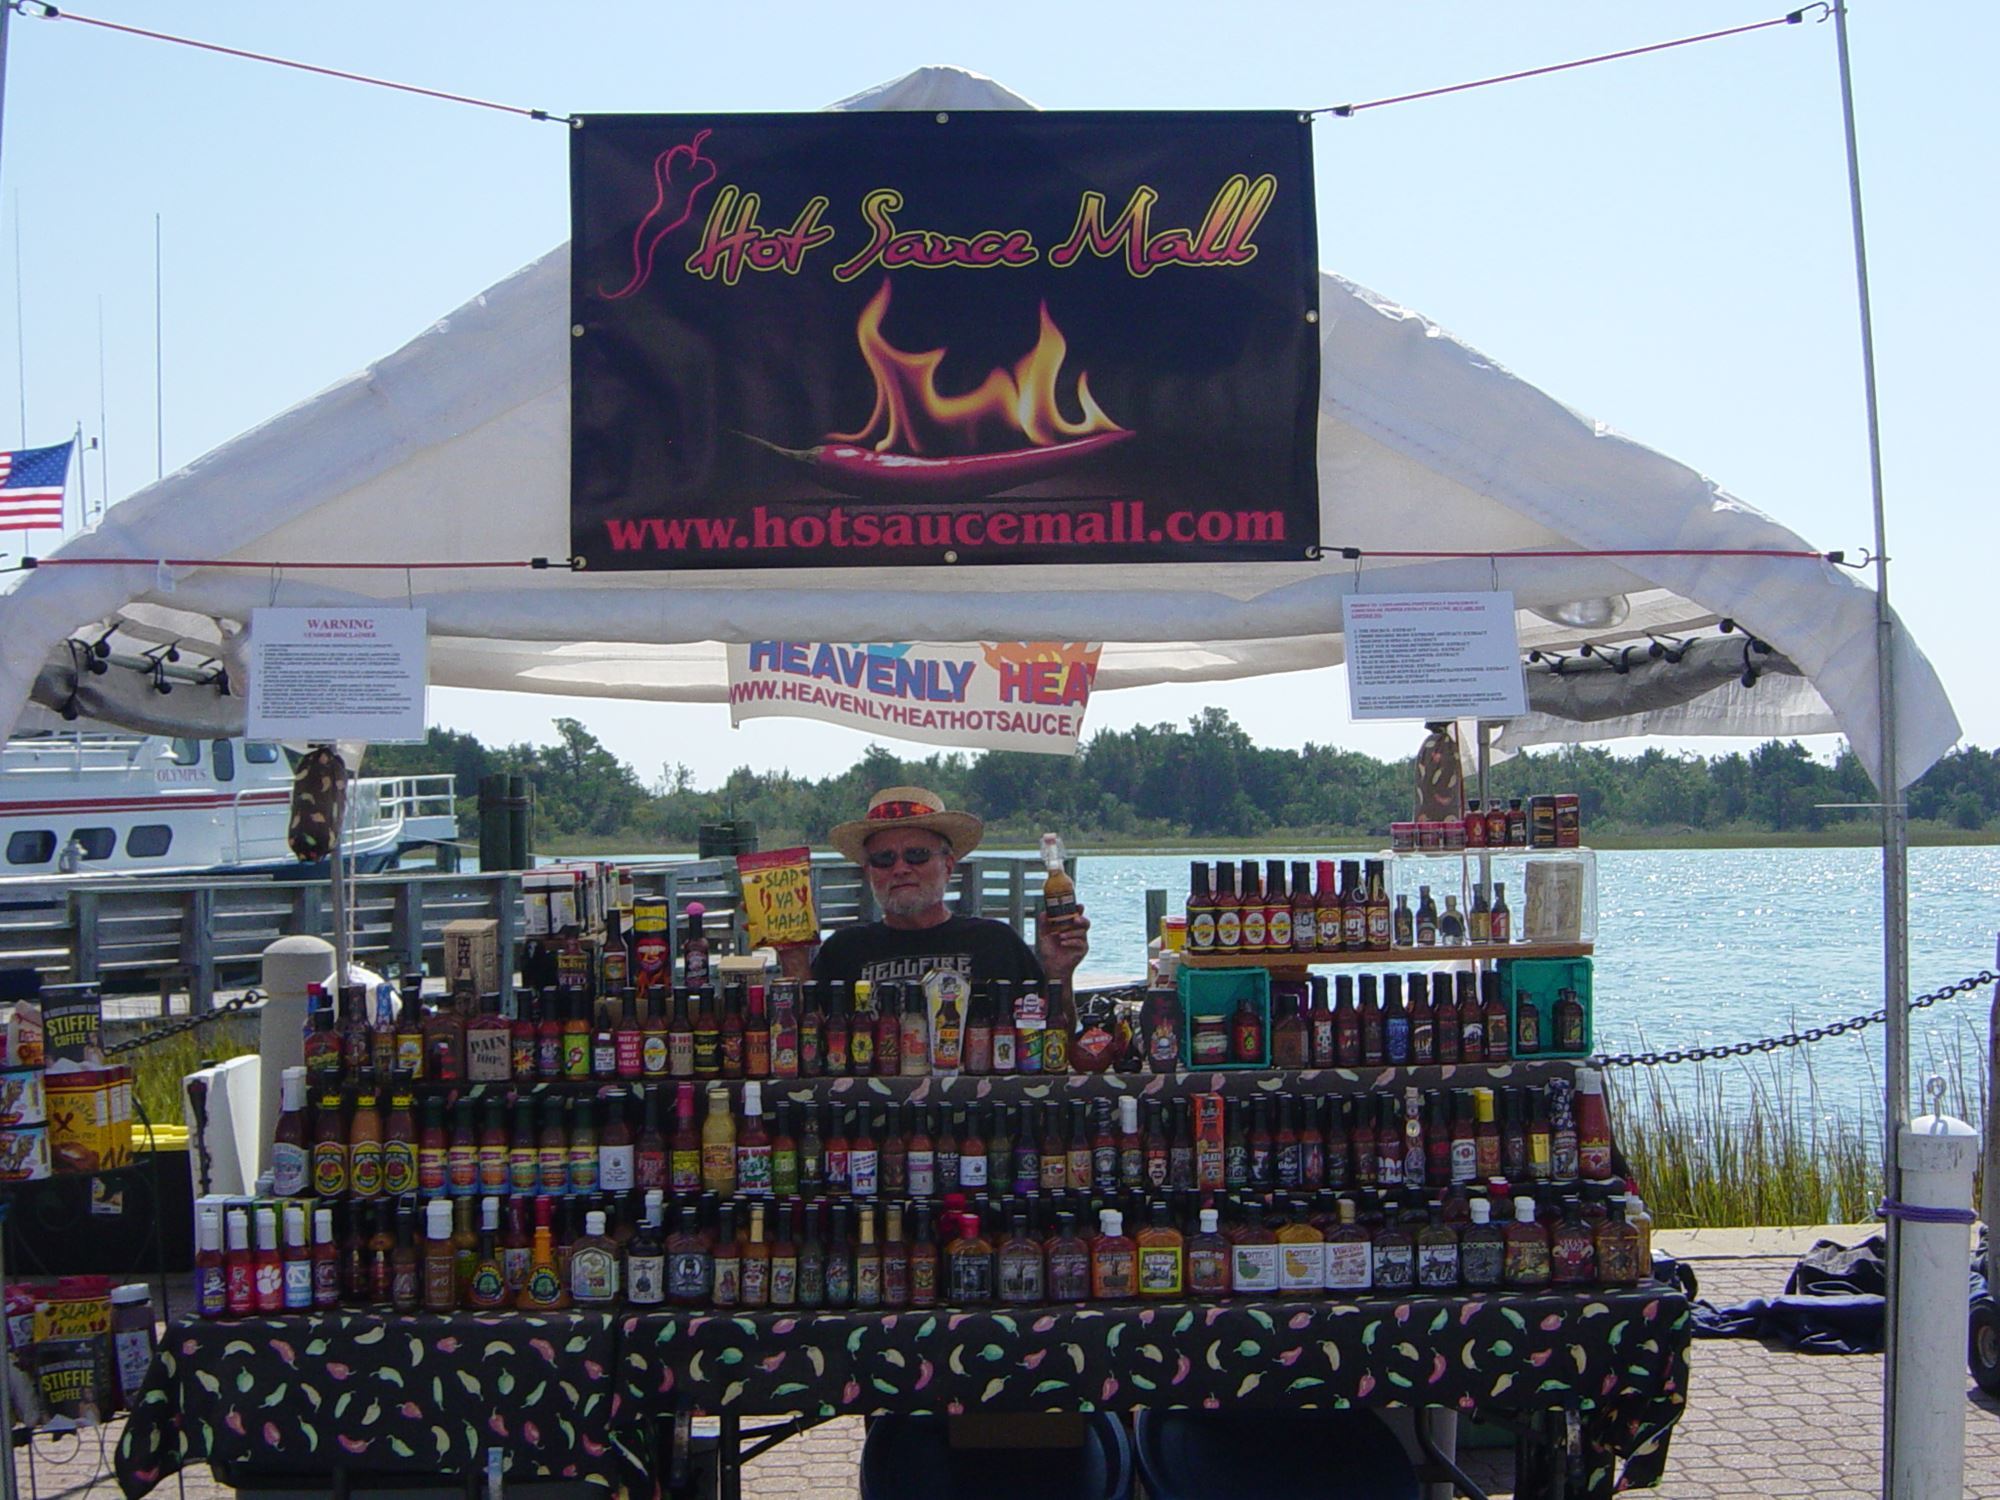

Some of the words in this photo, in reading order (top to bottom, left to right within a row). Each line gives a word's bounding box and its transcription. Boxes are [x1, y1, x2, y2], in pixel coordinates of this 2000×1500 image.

[686, 184, 835, 285] Hot
[834, 190, 1040, 282] Sauce
[1049, 173, 1277, 277] Mall
[606, 501, 1286, 550] www.hotsaucemall.com
[307, 619, 374, 630] WARNING
[749, 640, 975, 702] HEAVENLY
[157, 768, 206, 781] OLYMPUS
[766, 871, 800, 889] SLAP
[776, 893, 794, 907] YA
[767, 913, 810, 931] MAMA
[862, 956, 973, 982] HELLFIRE
[46, 1014, 99, 1036] STIFFIE
[54, 1032, 87, 1047] COFFEE
[470, 1034, 506, 1052] PAIN
[42, 1370, 94, 1391] STIFFIE
[51, 1387, 81, 1403] COFFEE
